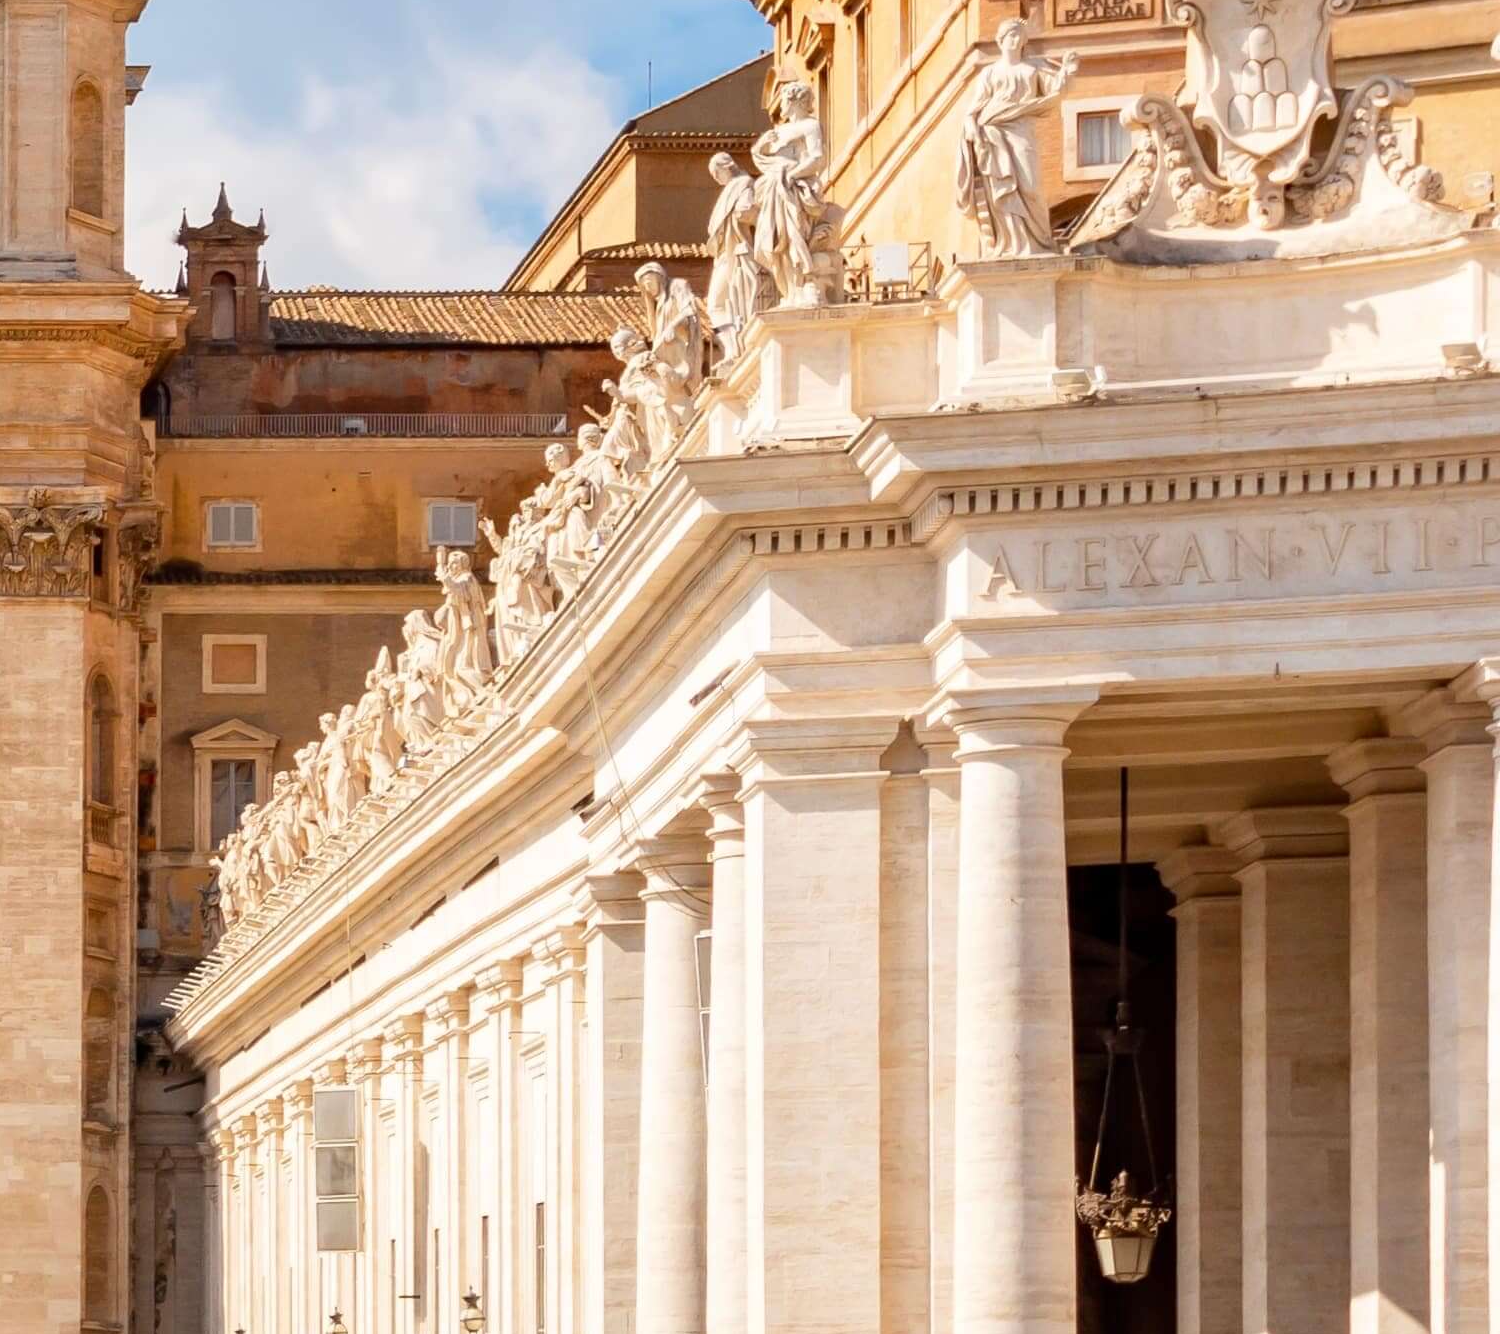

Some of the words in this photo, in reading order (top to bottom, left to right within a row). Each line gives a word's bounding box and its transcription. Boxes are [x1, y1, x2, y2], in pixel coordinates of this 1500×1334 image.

[1065, 3, 1146, 22] ECCLESIAE
[979, 528, 1275, 596] ALEXAN
[1311, 517, 1434, 576] VII
